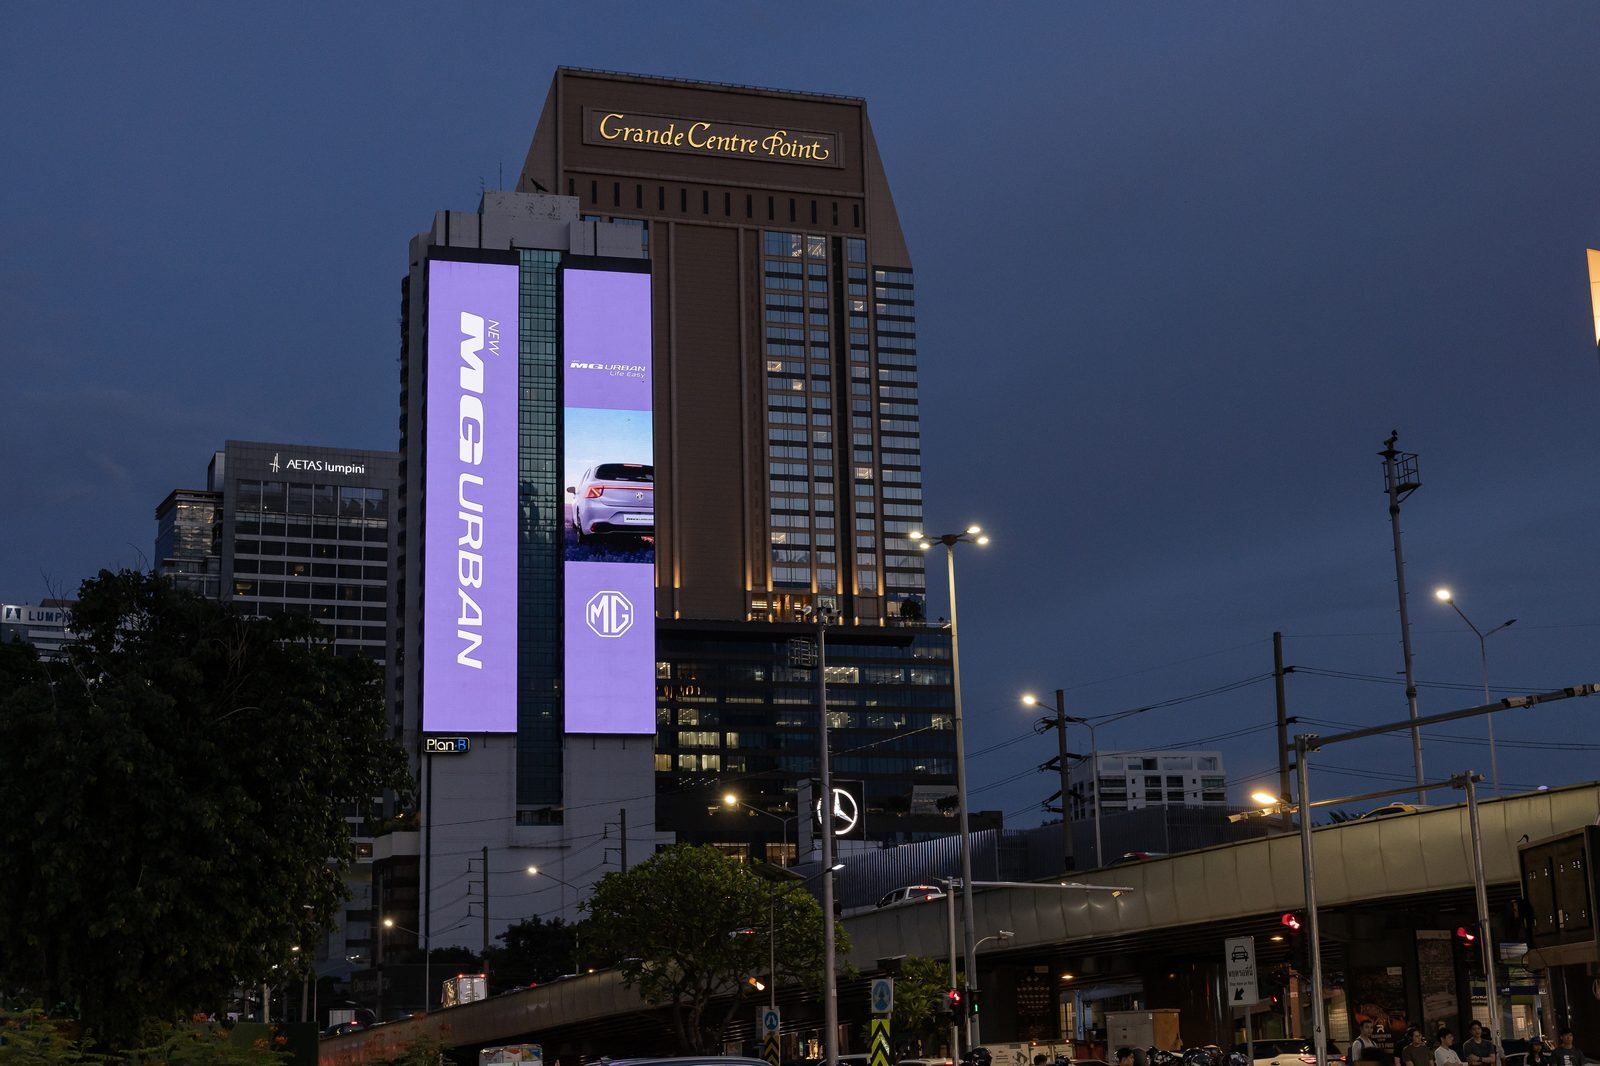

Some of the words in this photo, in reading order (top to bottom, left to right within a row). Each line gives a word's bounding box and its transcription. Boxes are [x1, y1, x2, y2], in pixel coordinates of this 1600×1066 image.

[599, 113, 684, 147] Grande
[687, 122, 759, 154] Centre
[761, 130, 829, 160] Point
[487, 319, 500, 356] NEW
[458, 311, 485, 466] MG
[286, 459, 323, 472] AETAS
[324, 461, 365, 475] lumpini
[457, 472, 484, 670] URBAN
